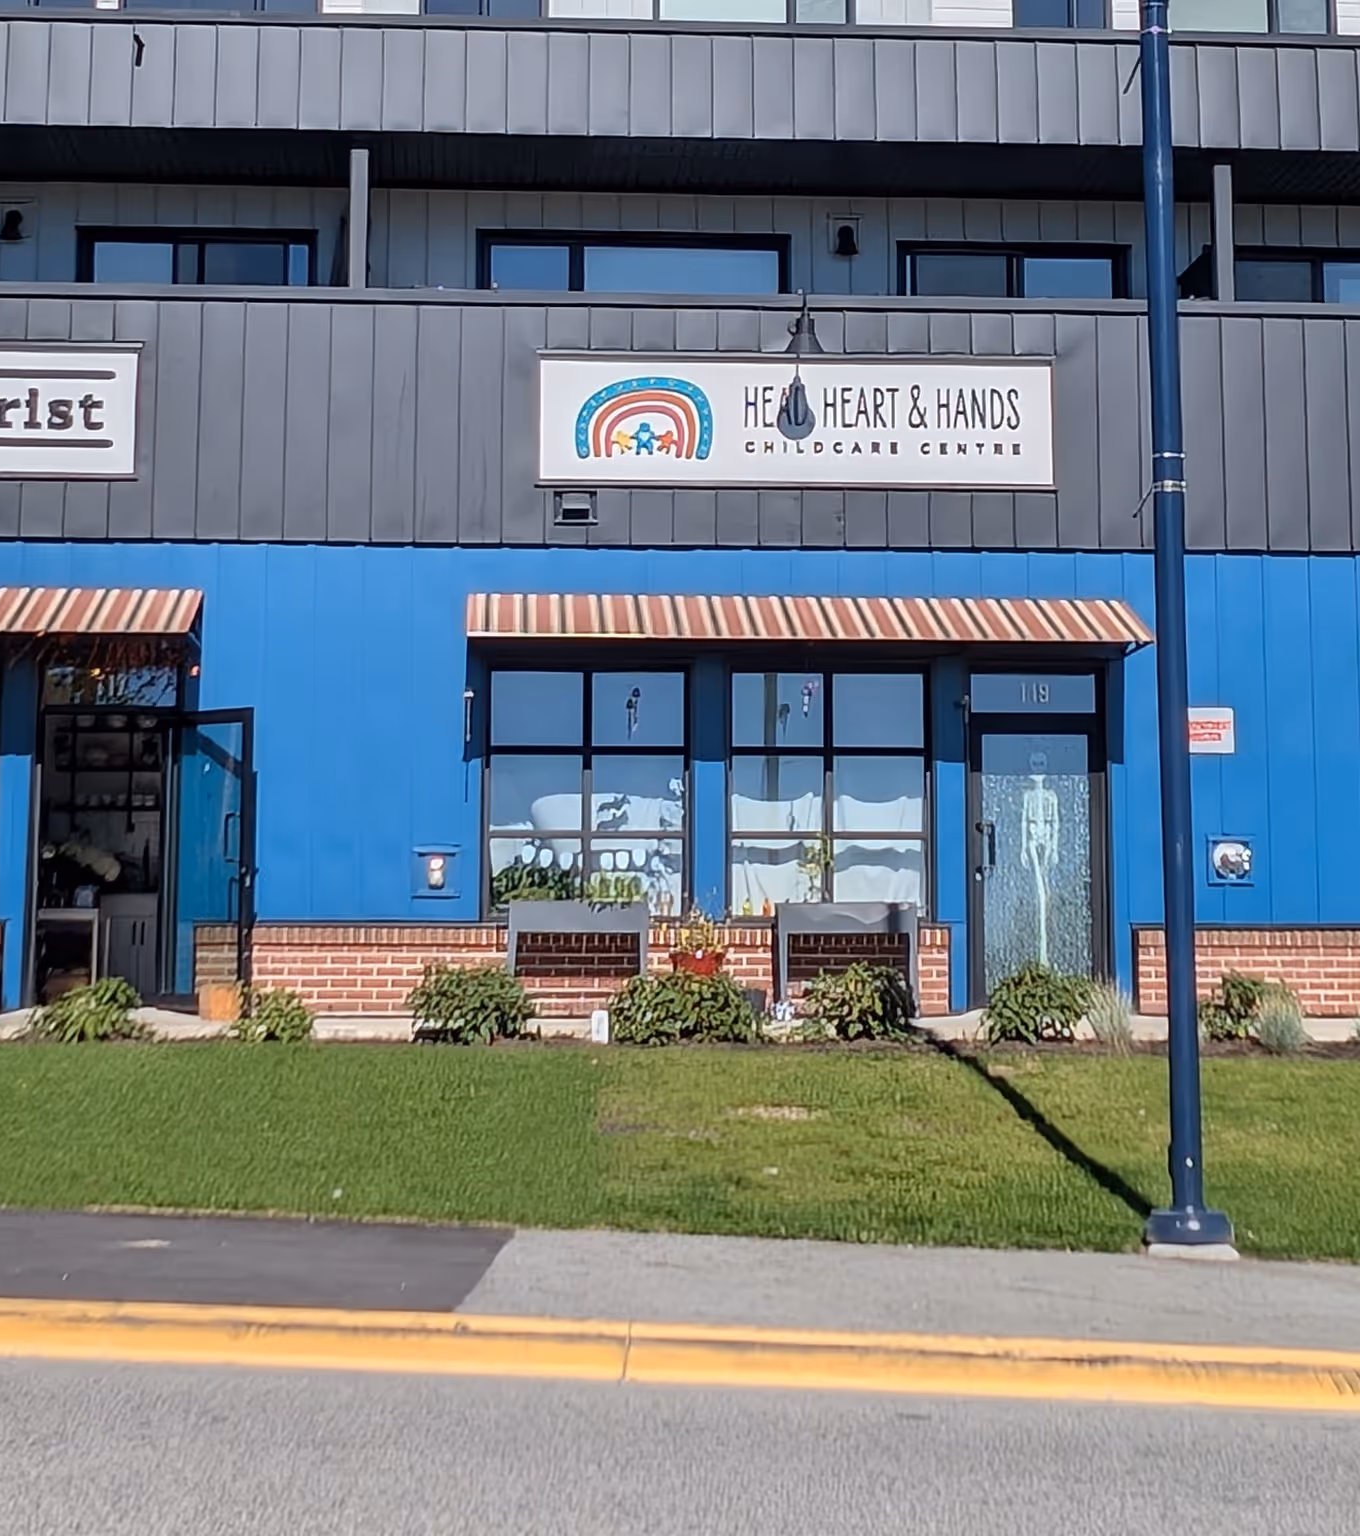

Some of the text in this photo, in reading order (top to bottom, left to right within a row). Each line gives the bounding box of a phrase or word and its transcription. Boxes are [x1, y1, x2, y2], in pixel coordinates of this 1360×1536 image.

[823, 386, 900, 429] HEART
[908, 384, 928, 429] &
[936, 388, 1021, 431] HANDS
[745, 441, 1021, 456] CHILDCARE CENTRE
